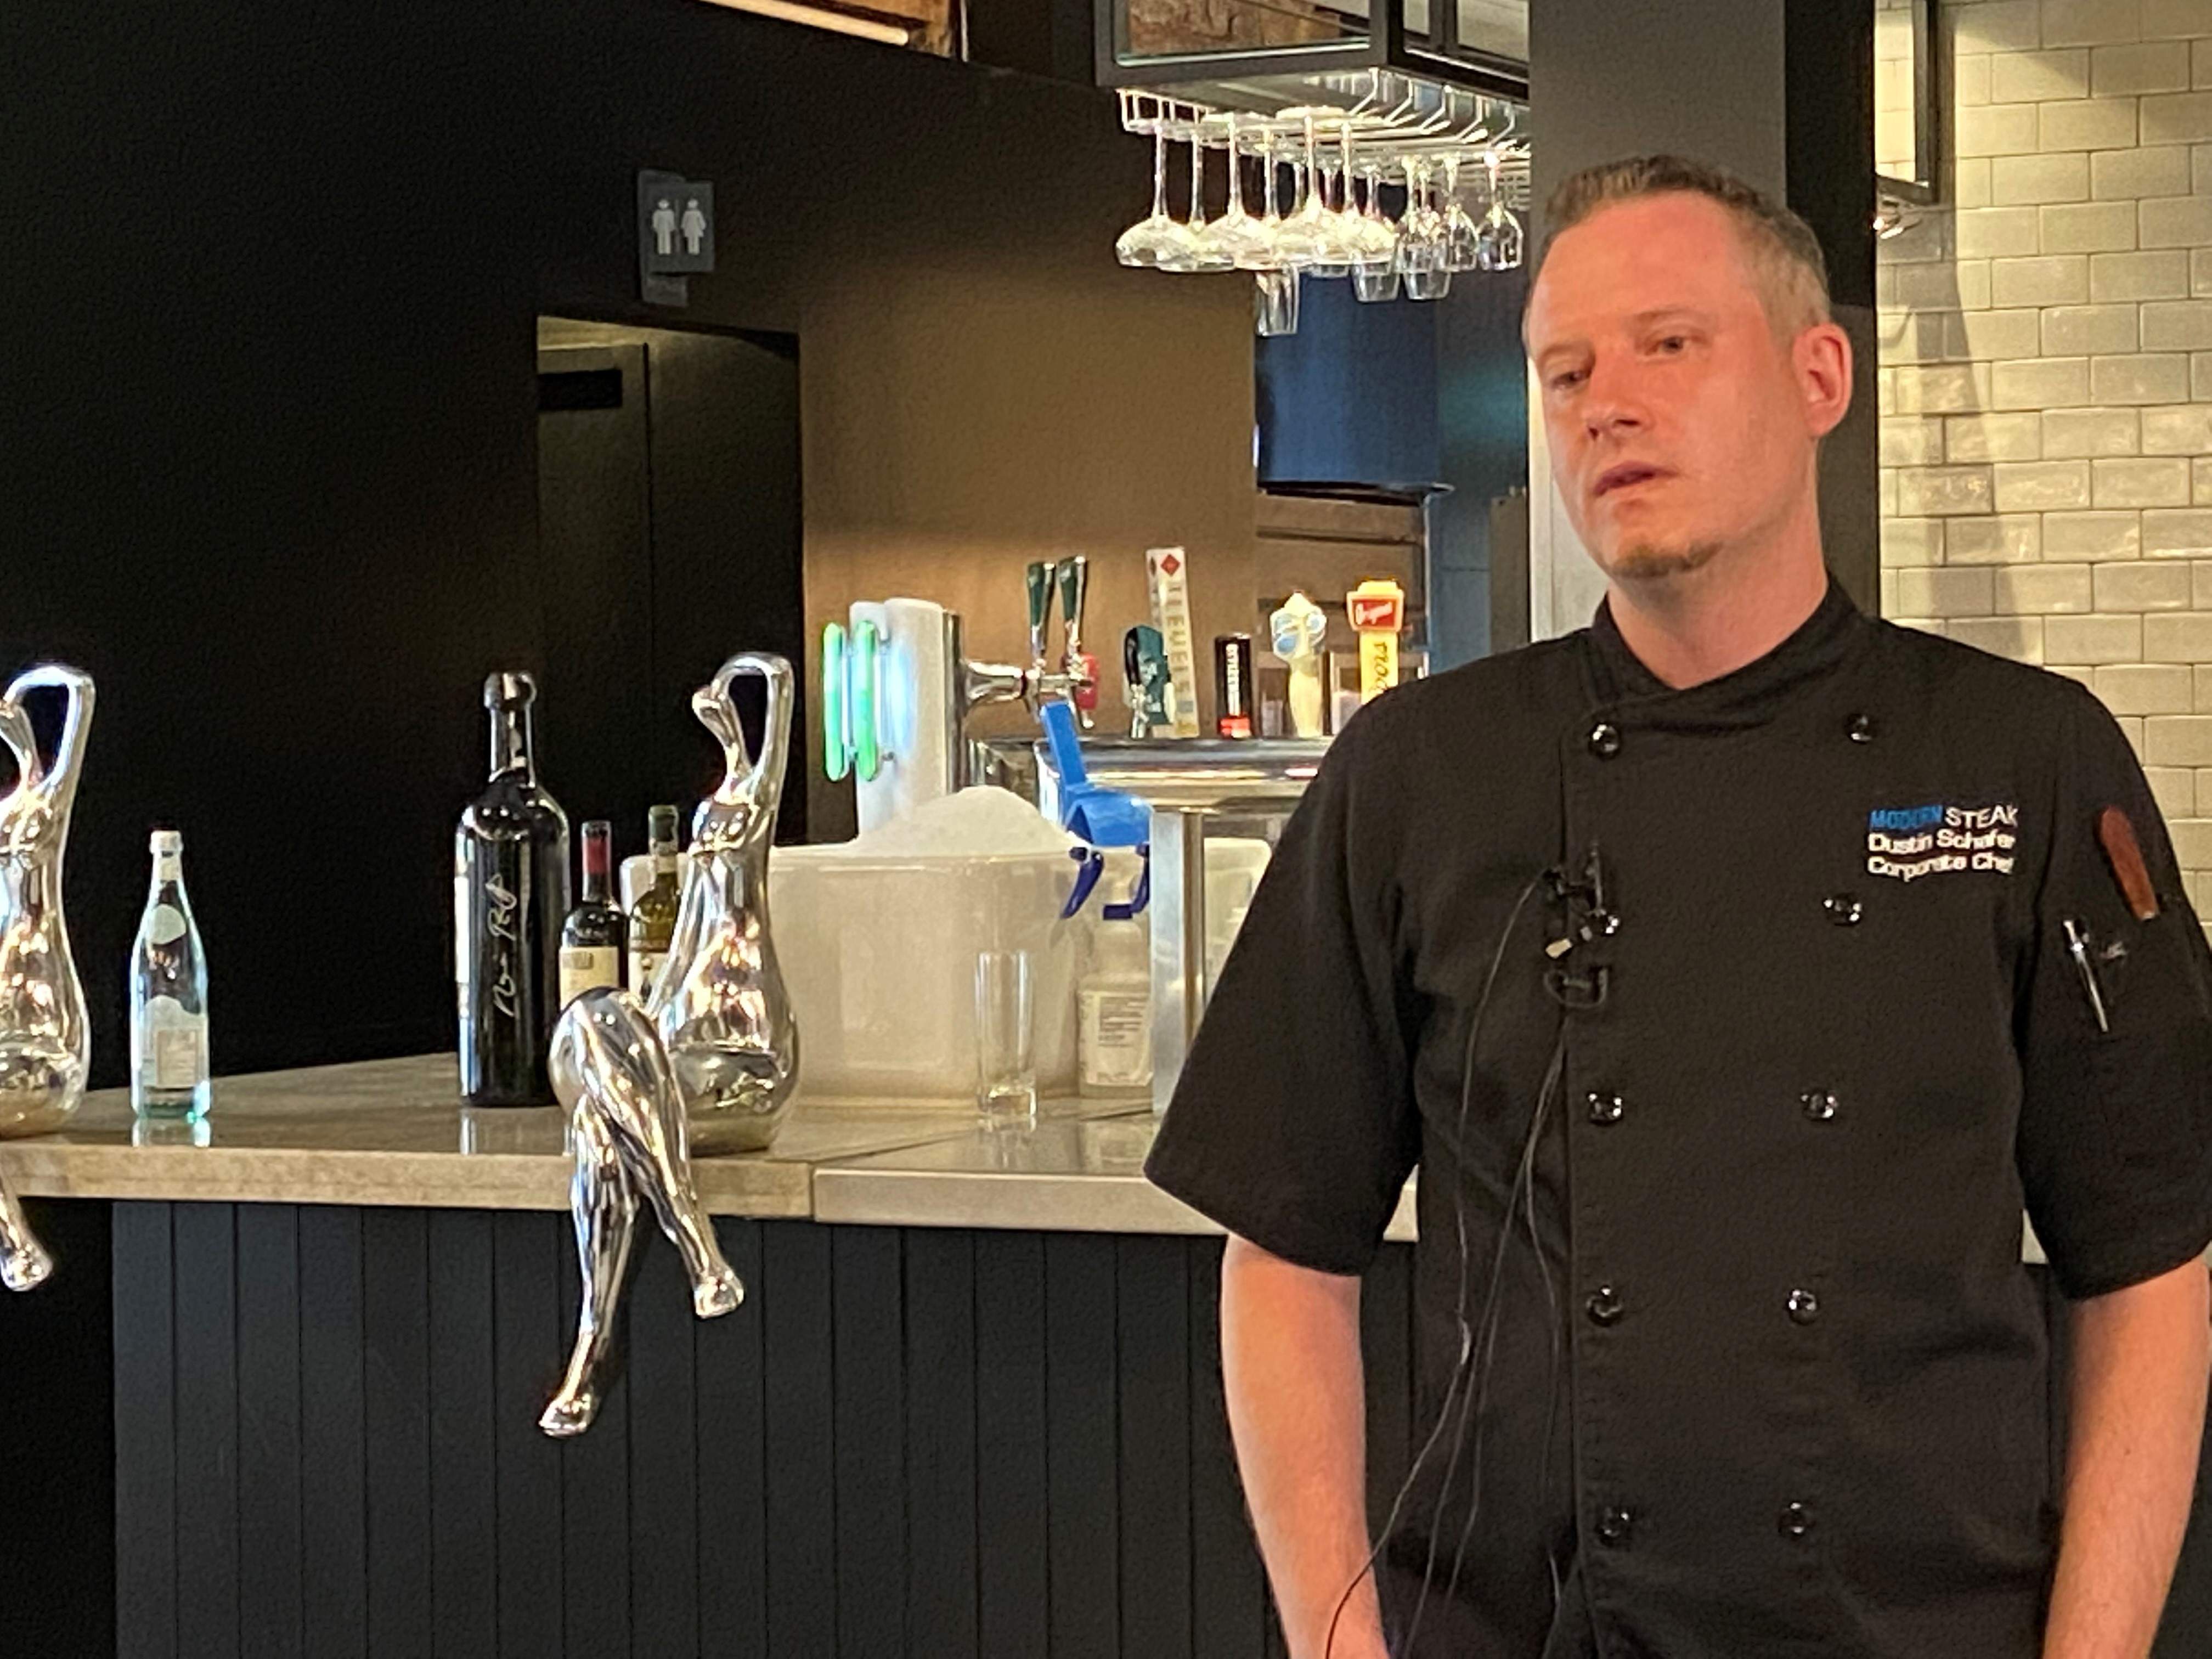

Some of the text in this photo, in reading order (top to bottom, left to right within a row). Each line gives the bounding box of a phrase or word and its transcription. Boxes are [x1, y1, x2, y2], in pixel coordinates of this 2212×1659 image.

[1945, 804, 2018, 829] STEAK
[1869, 832, 1933, 855] Dustin
[1867, 854, 1967, 882] Corporate
